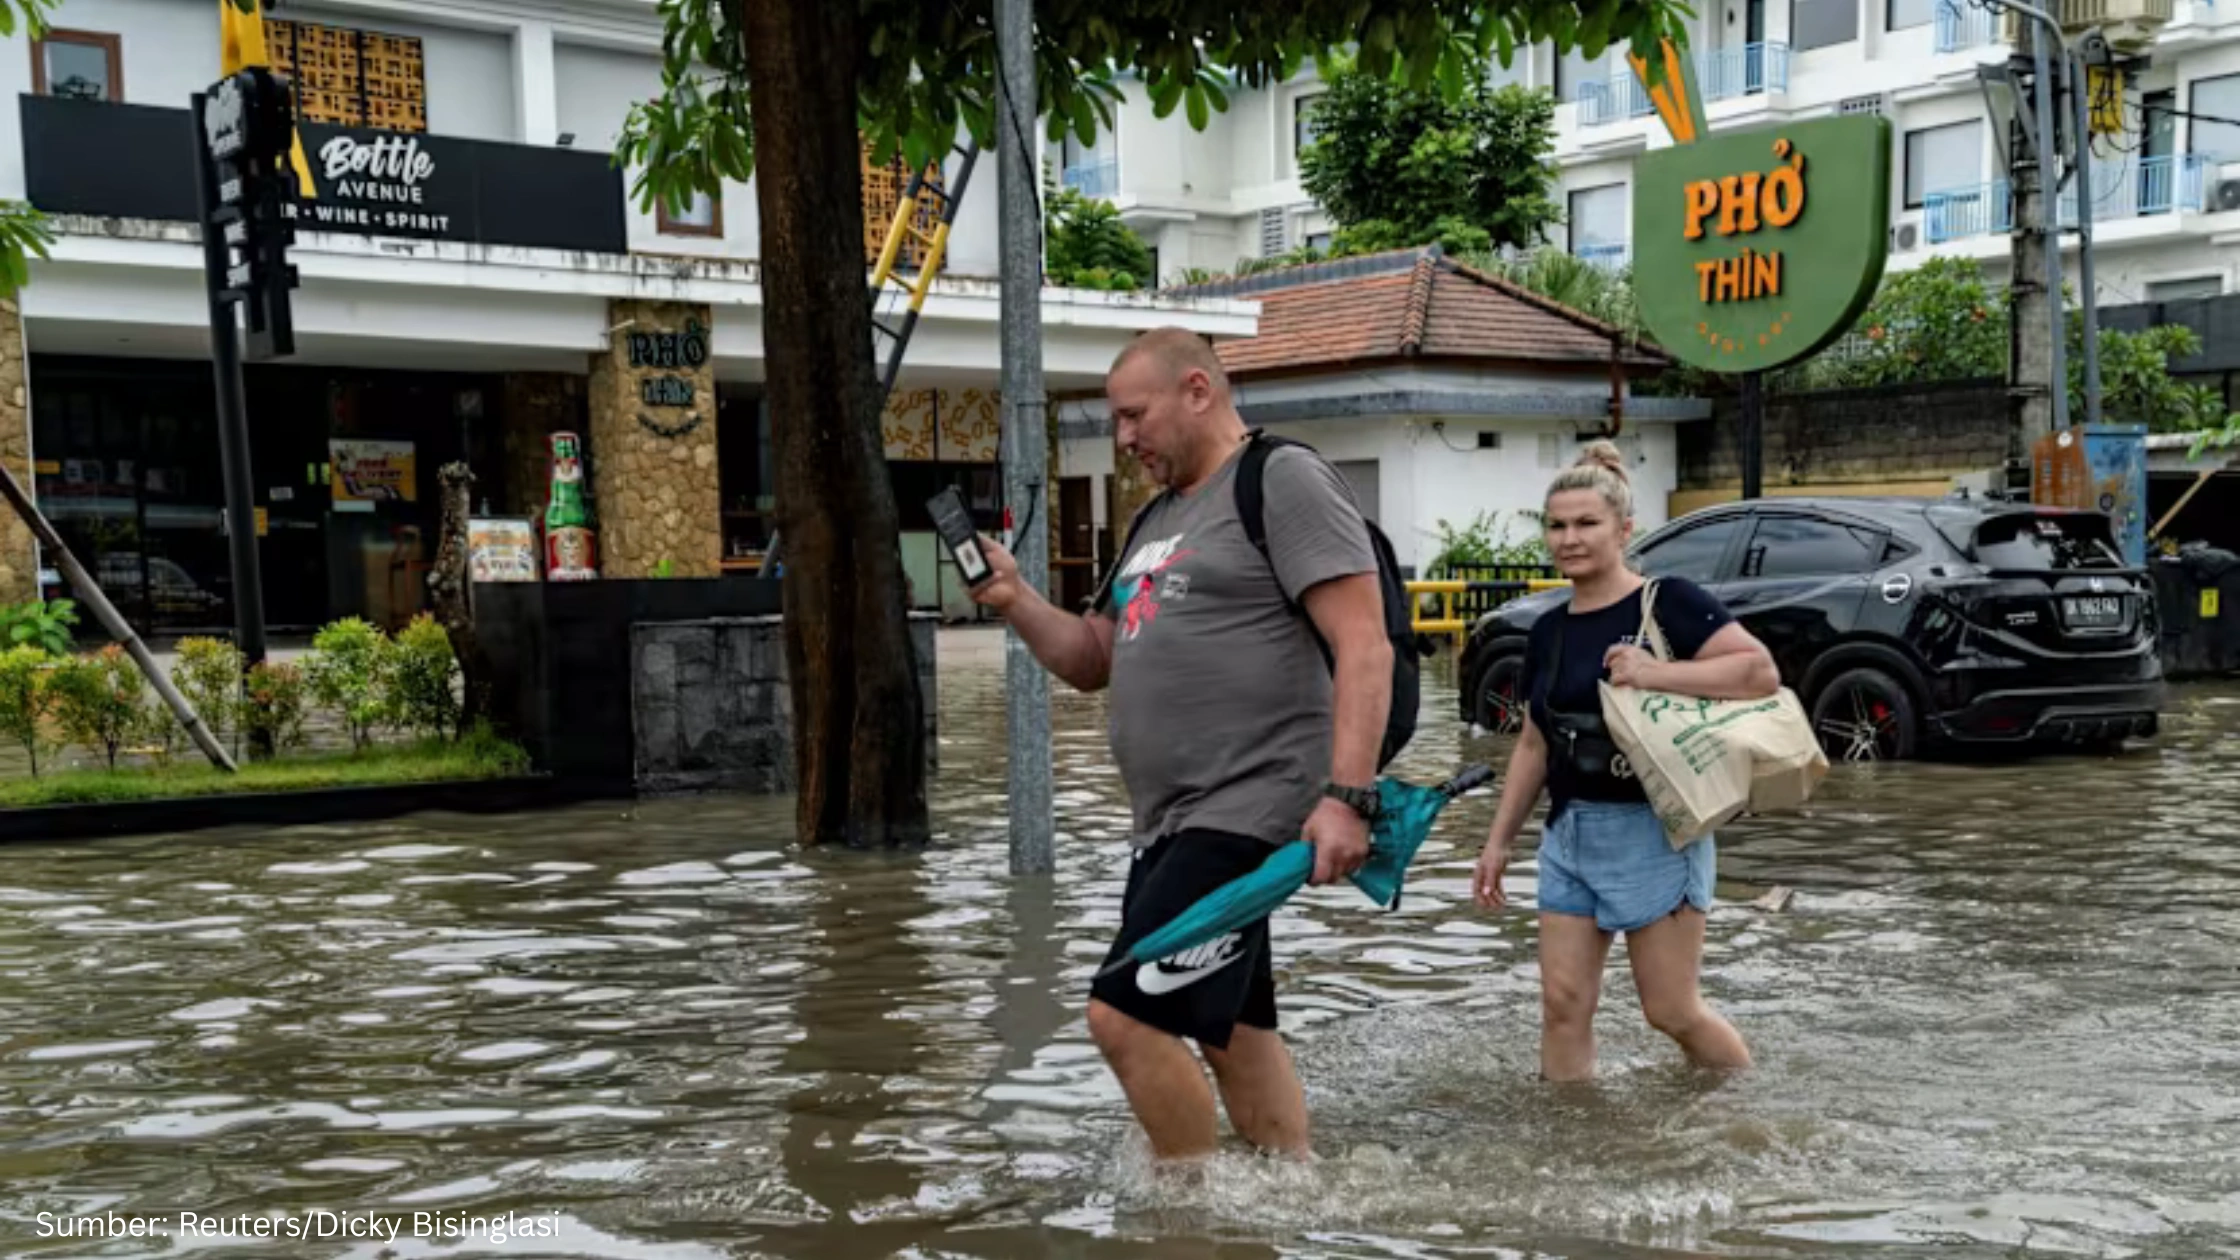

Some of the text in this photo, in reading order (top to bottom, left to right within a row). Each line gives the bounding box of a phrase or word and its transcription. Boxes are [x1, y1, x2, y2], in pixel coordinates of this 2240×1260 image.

[319, 135, 435, 185] Bottle
[337, 179, 423, 204] AVENUE
[1684, 139, 1804, 241] PHỞ
[315, 205, 369, 225] WINE
[384, 211, 449, 232] SPIRIT
